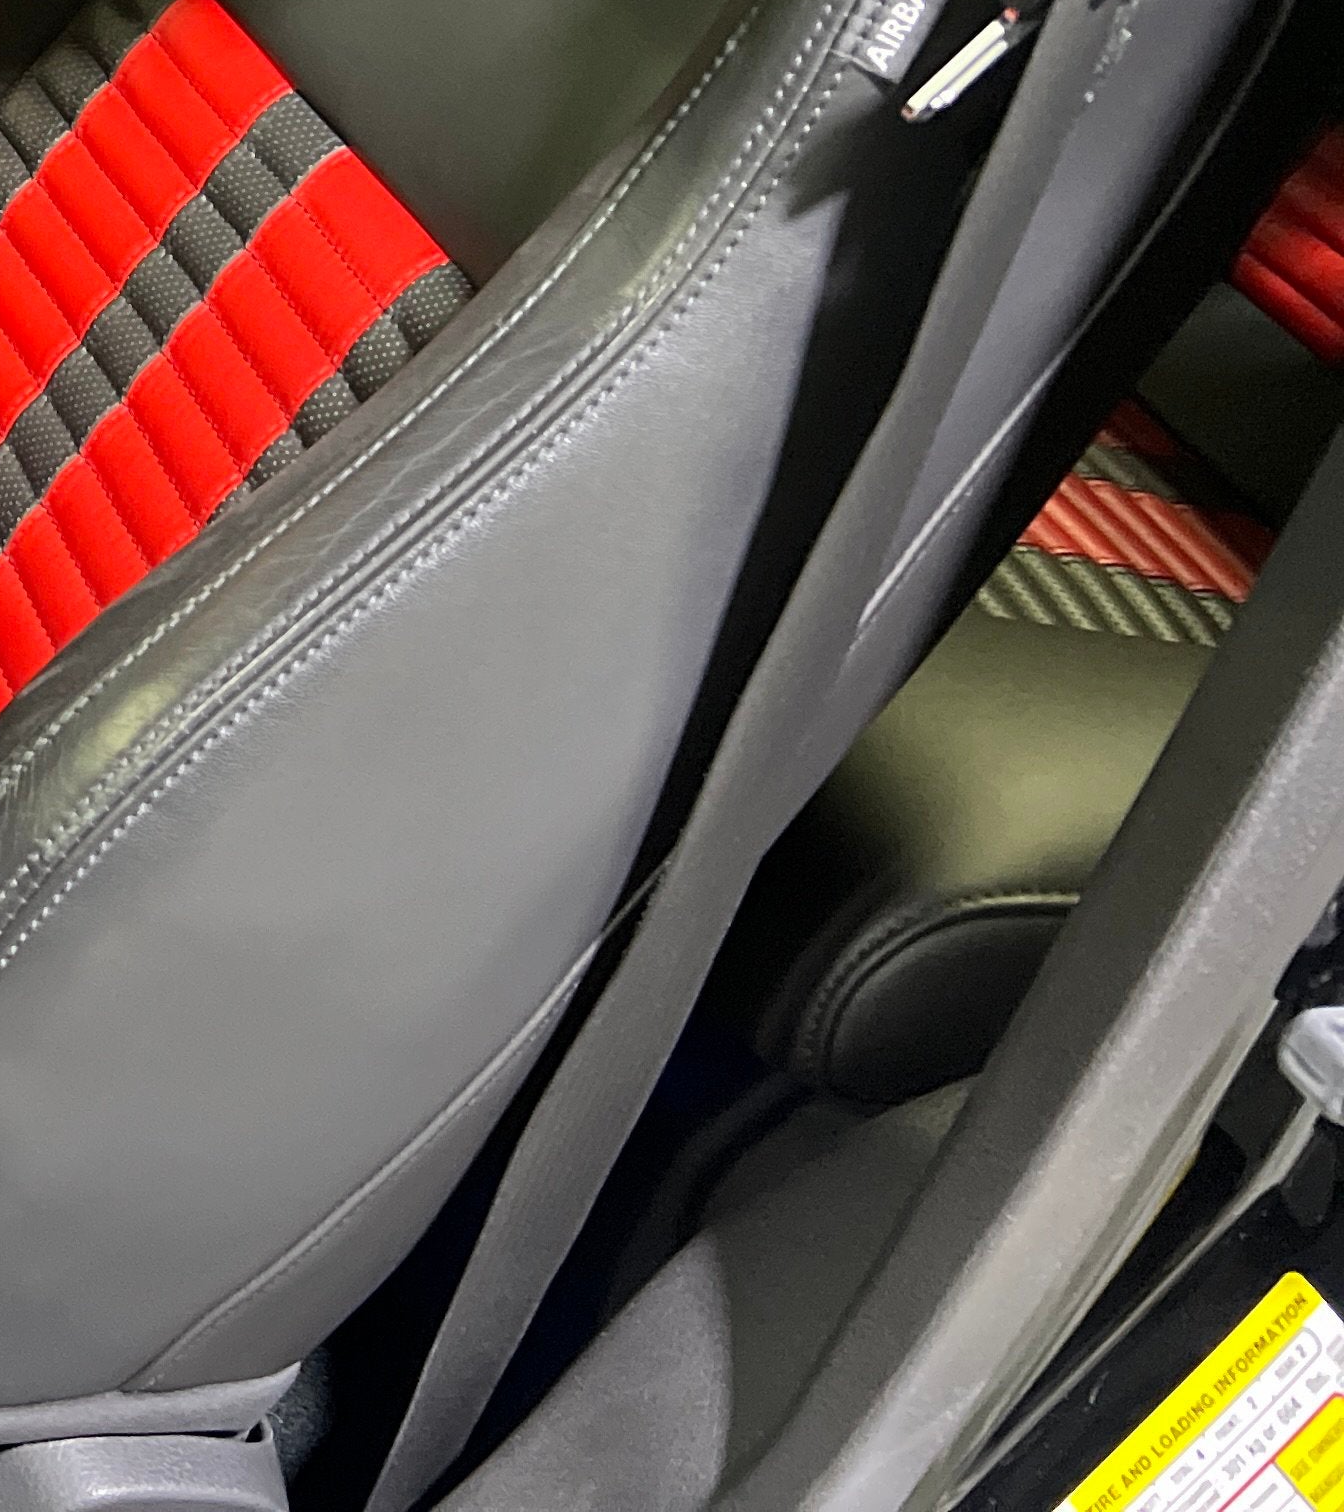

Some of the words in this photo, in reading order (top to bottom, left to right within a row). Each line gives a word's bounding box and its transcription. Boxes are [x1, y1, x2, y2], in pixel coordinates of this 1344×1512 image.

[1121, 1456, 1153, 1488] AND
[1151, 1393, 1214, 1458] LOADING
[1214, 1293, 1309, 1397] INFORMATION
